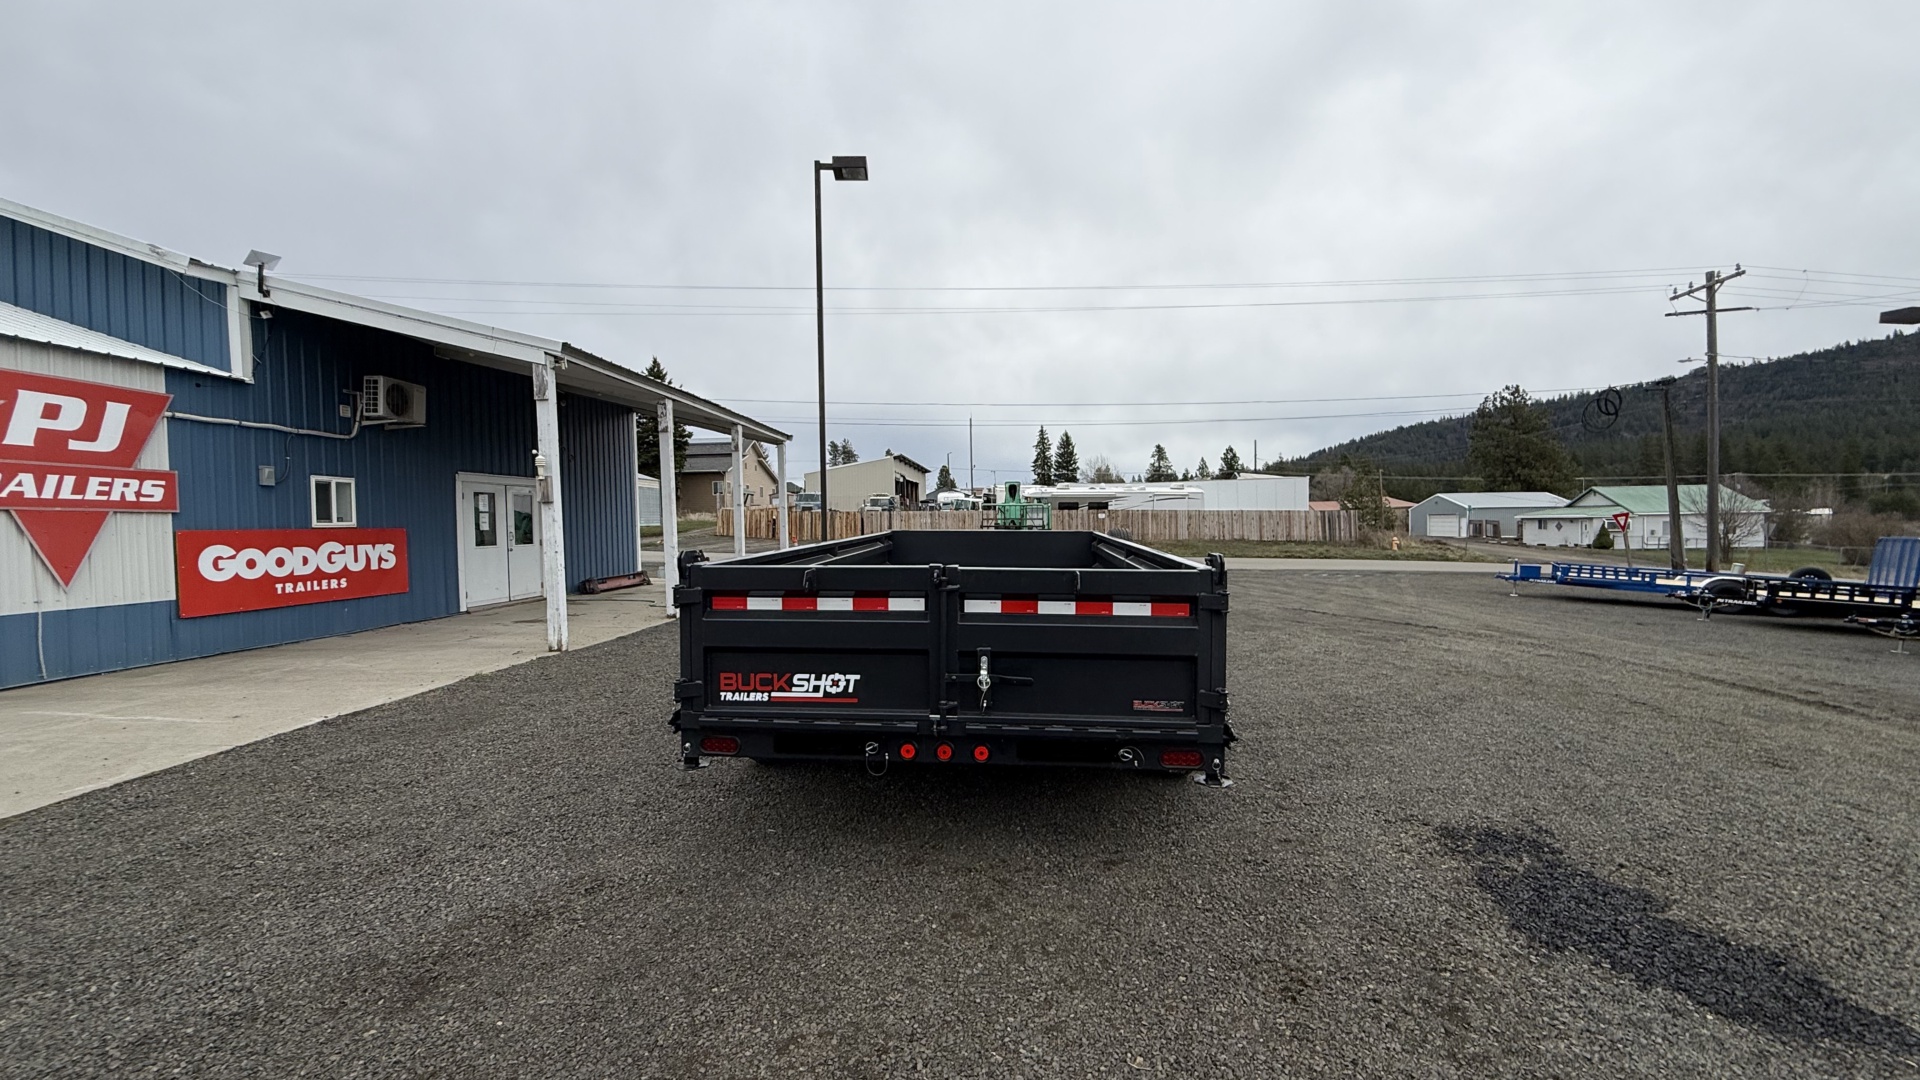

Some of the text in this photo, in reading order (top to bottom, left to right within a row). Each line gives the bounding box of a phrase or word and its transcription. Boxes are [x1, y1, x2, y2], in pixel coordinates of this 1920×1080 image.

[2, 389, 132, 453] PJ
[0, 473, 166, 502] AILERS
[275, 578, 347, 594] TRAILERS
[719, 672, 861, 694] BUCKSHOT
[719, 692, 769, 702] TRAILERS
